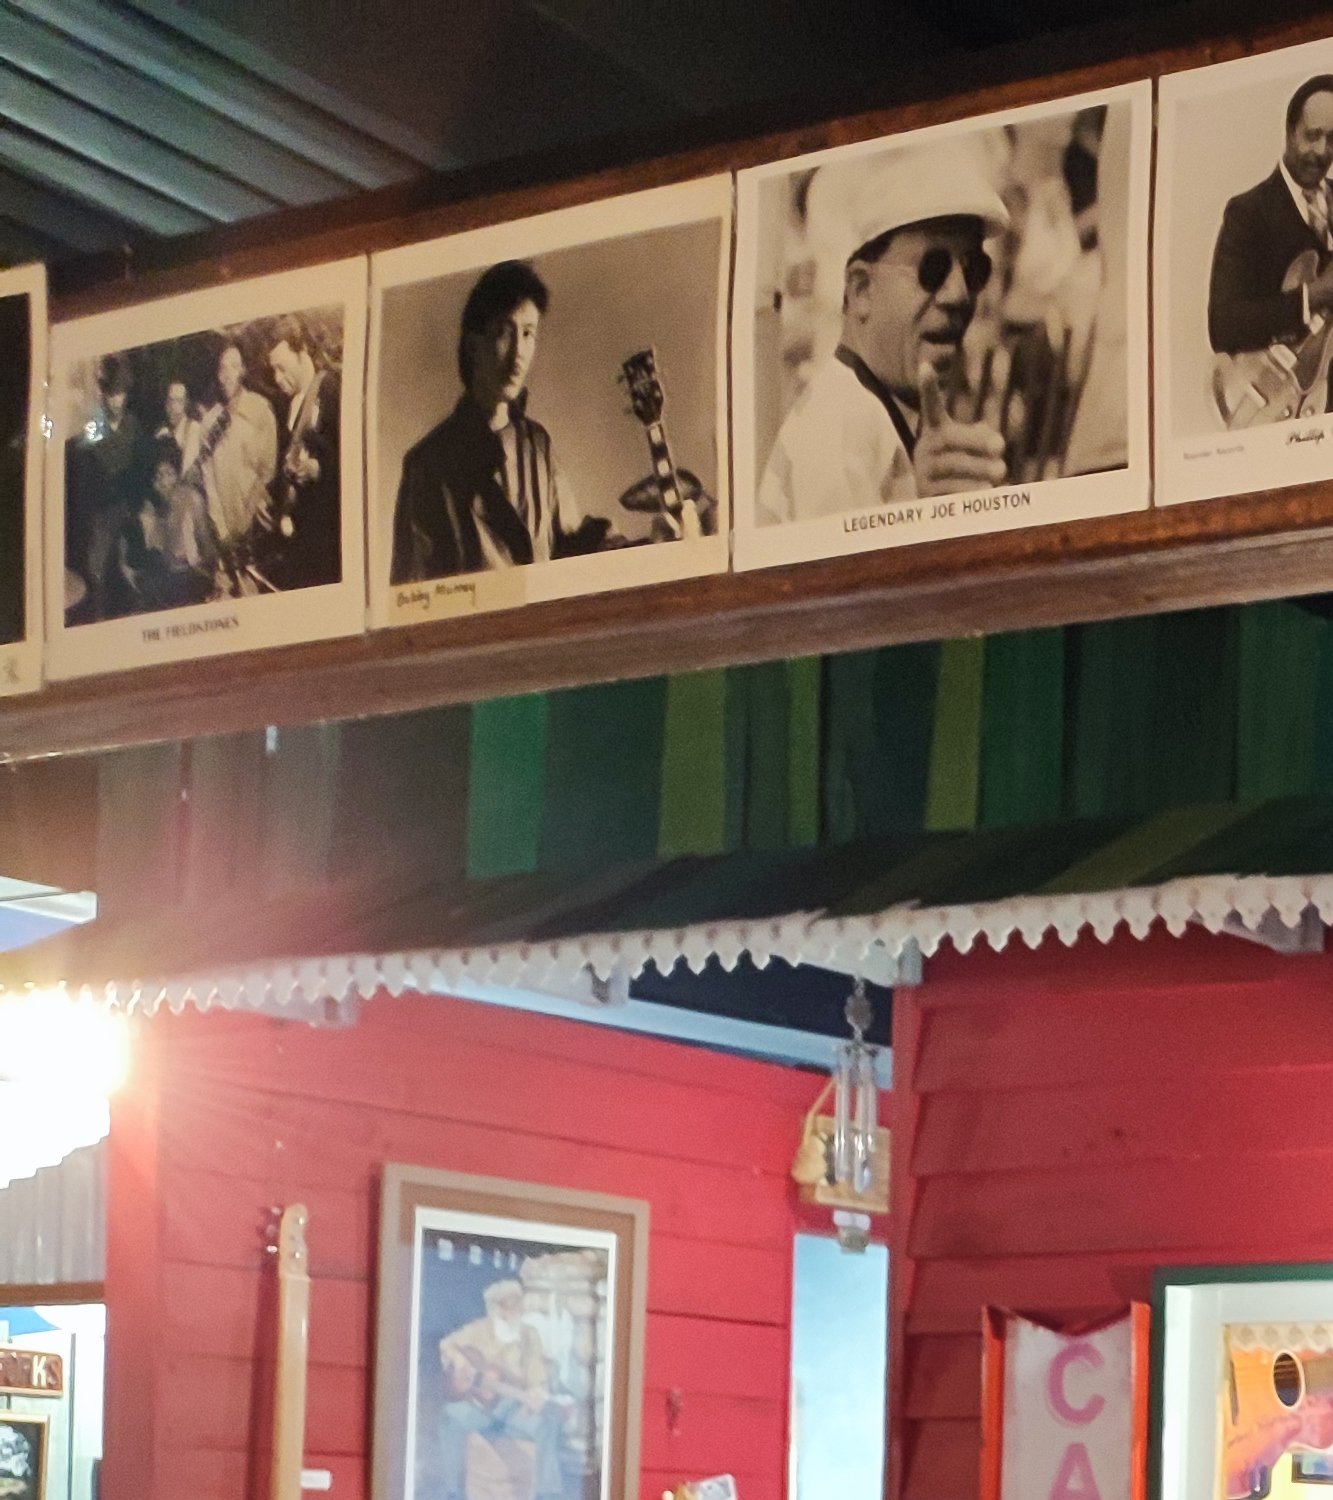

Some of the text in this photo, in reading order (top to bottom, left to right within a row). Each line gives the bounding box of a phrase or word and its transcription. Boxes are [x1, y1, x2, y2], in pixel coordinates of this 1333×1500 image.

[843, 491, 1031, 533] LEGENDARY JOE HOUSTON
